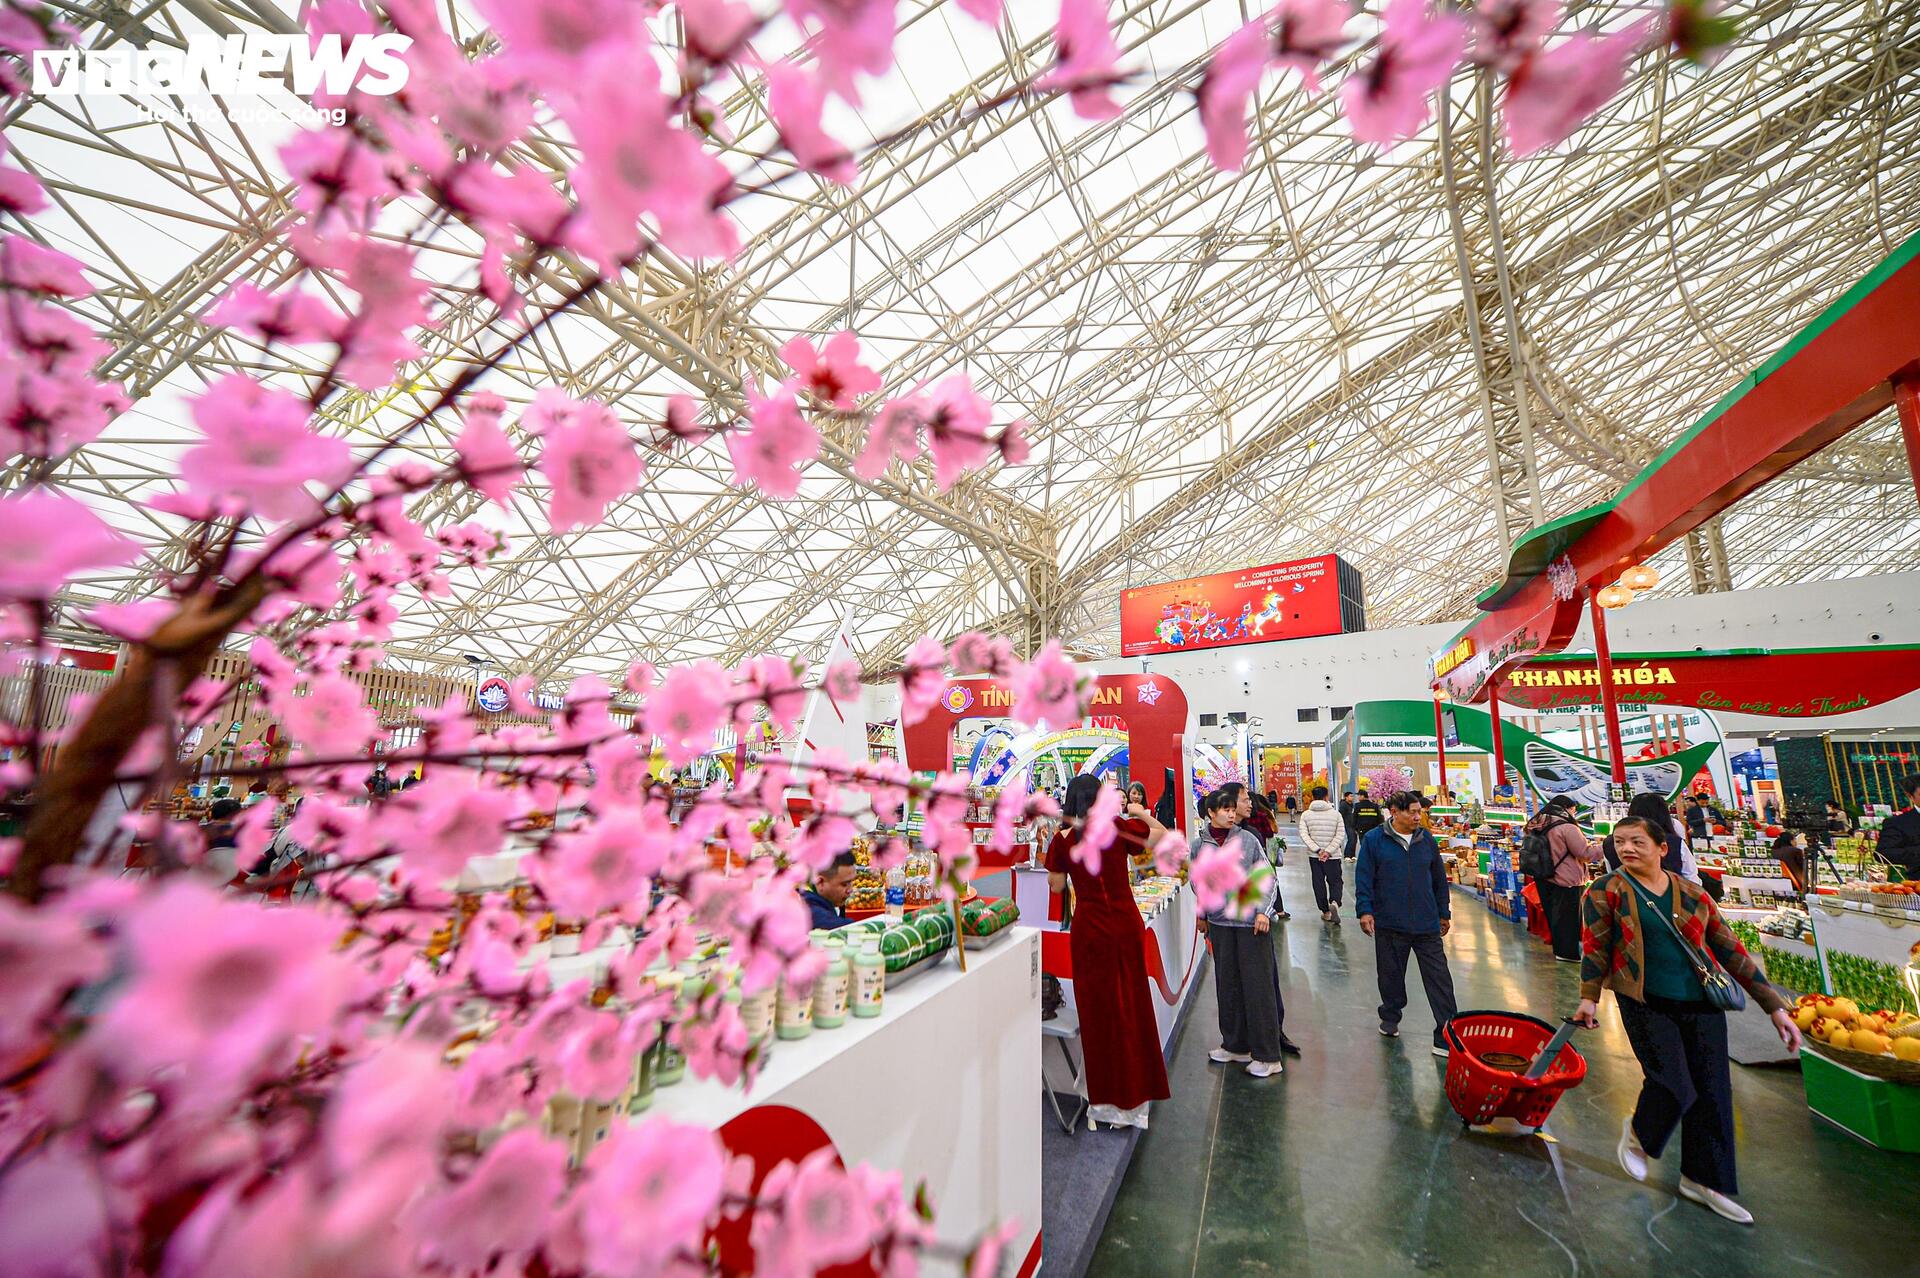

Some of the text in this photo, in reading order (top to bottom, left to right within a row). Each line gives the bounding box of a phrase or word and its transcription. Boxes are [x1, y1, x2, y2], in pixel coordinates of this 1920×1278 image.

[1233, 578, 1267, 589] WELCOMING
[1272, 572, 1302, 583] GLORIOUS
[1302, 568, 1325, 579] SPRING
[1252, 561, 1324, 579] CONNECTING PROSPERITY
[1507, 661, 1676, 687] THANH HÓA
[1090, 686, 1122, 704] AN
[1810, 693, 1869, 715] Thanh
